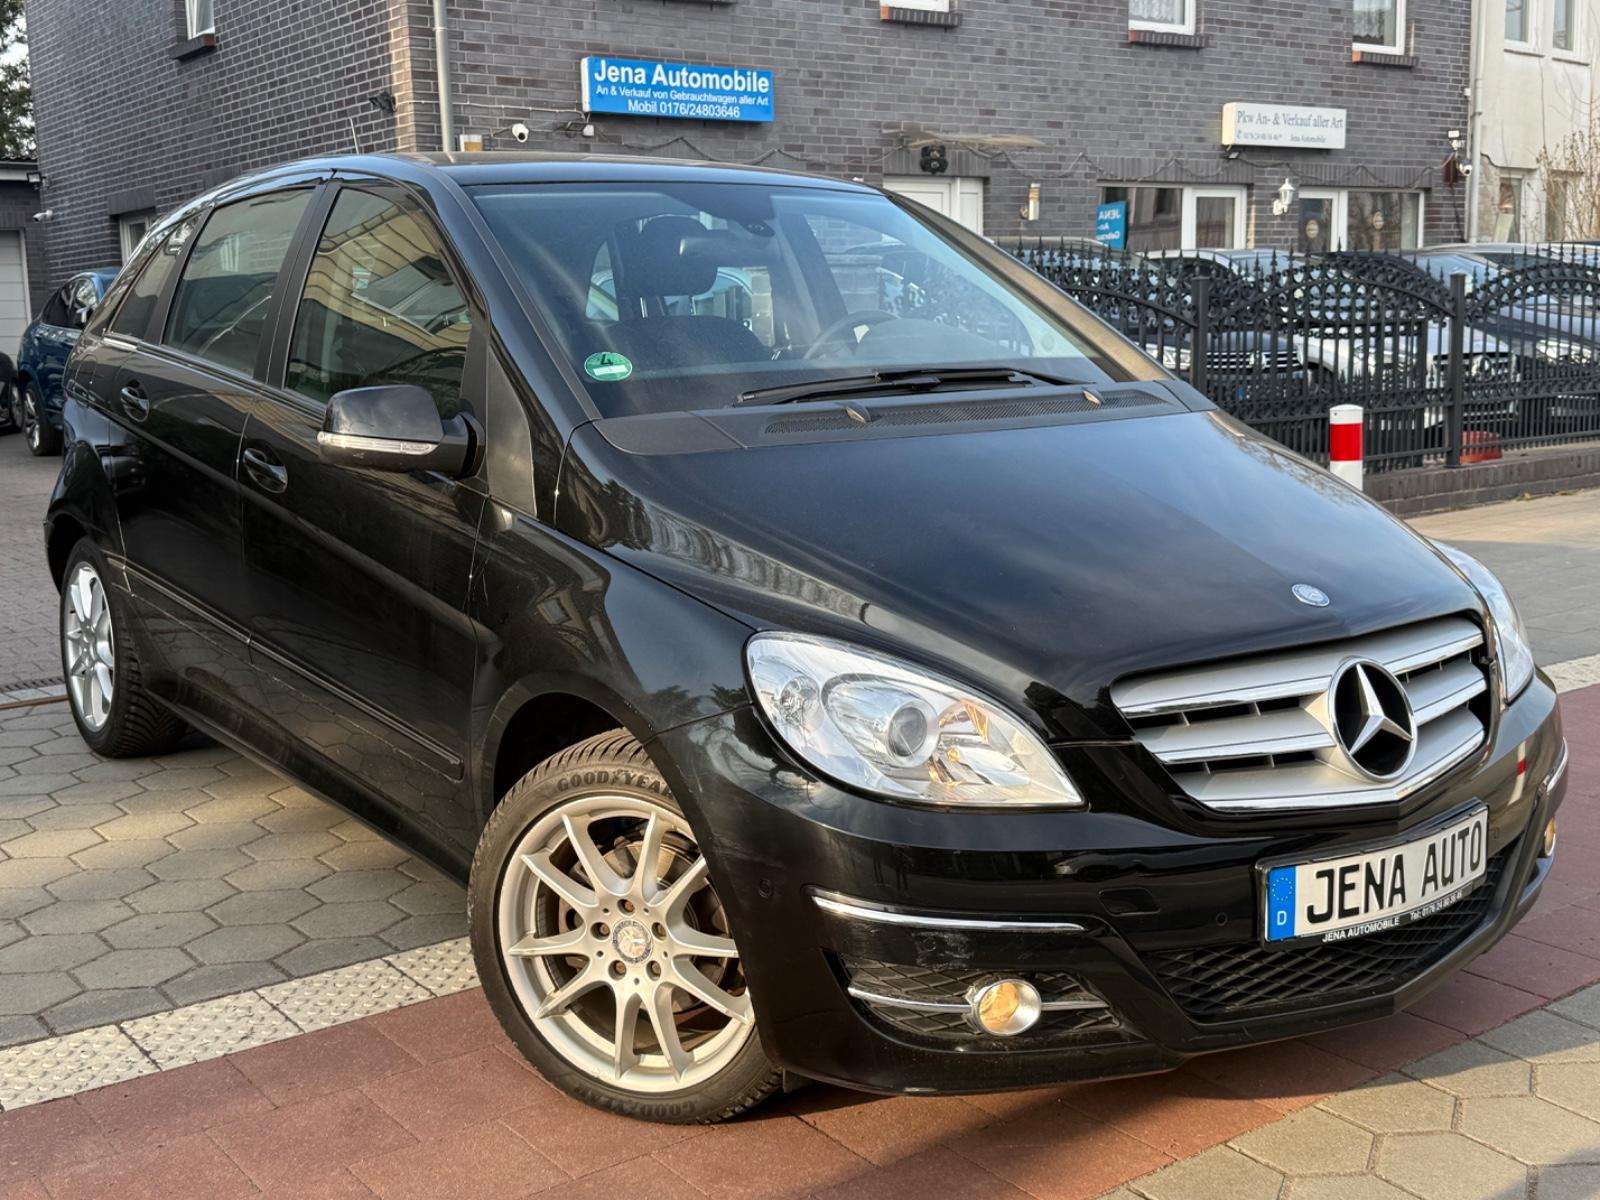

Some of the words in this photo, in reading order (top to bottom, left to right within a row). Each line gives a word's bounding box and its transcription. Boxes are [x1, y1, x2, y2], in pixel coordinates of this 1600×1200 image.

[594, 59, 646, 84] Jena
[651, 64, 770, 93] Automobile
[596, 85, 609, 95] An
[610, 87, 617, 96] &
[619, 87, 651, 98] Verkauf
[652, 91, 668, 99] von
[669, 91, 738, 105] Gebrauchtwagen
[738, 96, 756, 105] aller
[756, 97, 769, 106] Art
[628, 99, 657, 113] Mobil
[659, 102, 741, 118] 0176/24803646
[1237, 110, 1254, 124] Pkw
[1255, 113, 1270, 125] An-
[1272, 113, 1280, 126] &
[1282, 113, 1313, 128] Verkauf
[1312, 115, 1330, 128] aller
[1330, 117, 1343, 128] Art
[601, 354, 614, 366] 4
[1307, 854, 1406, 924] JENA
[1421, 820, 1482, 898] AUTO
[1276, 910, 1288, 926] D
[1322, 930, 1347, 943] JENA
[1347, 917, 1400, 938] AUTOMOBILE
[1410, 909, 1422, 921] Tel:
